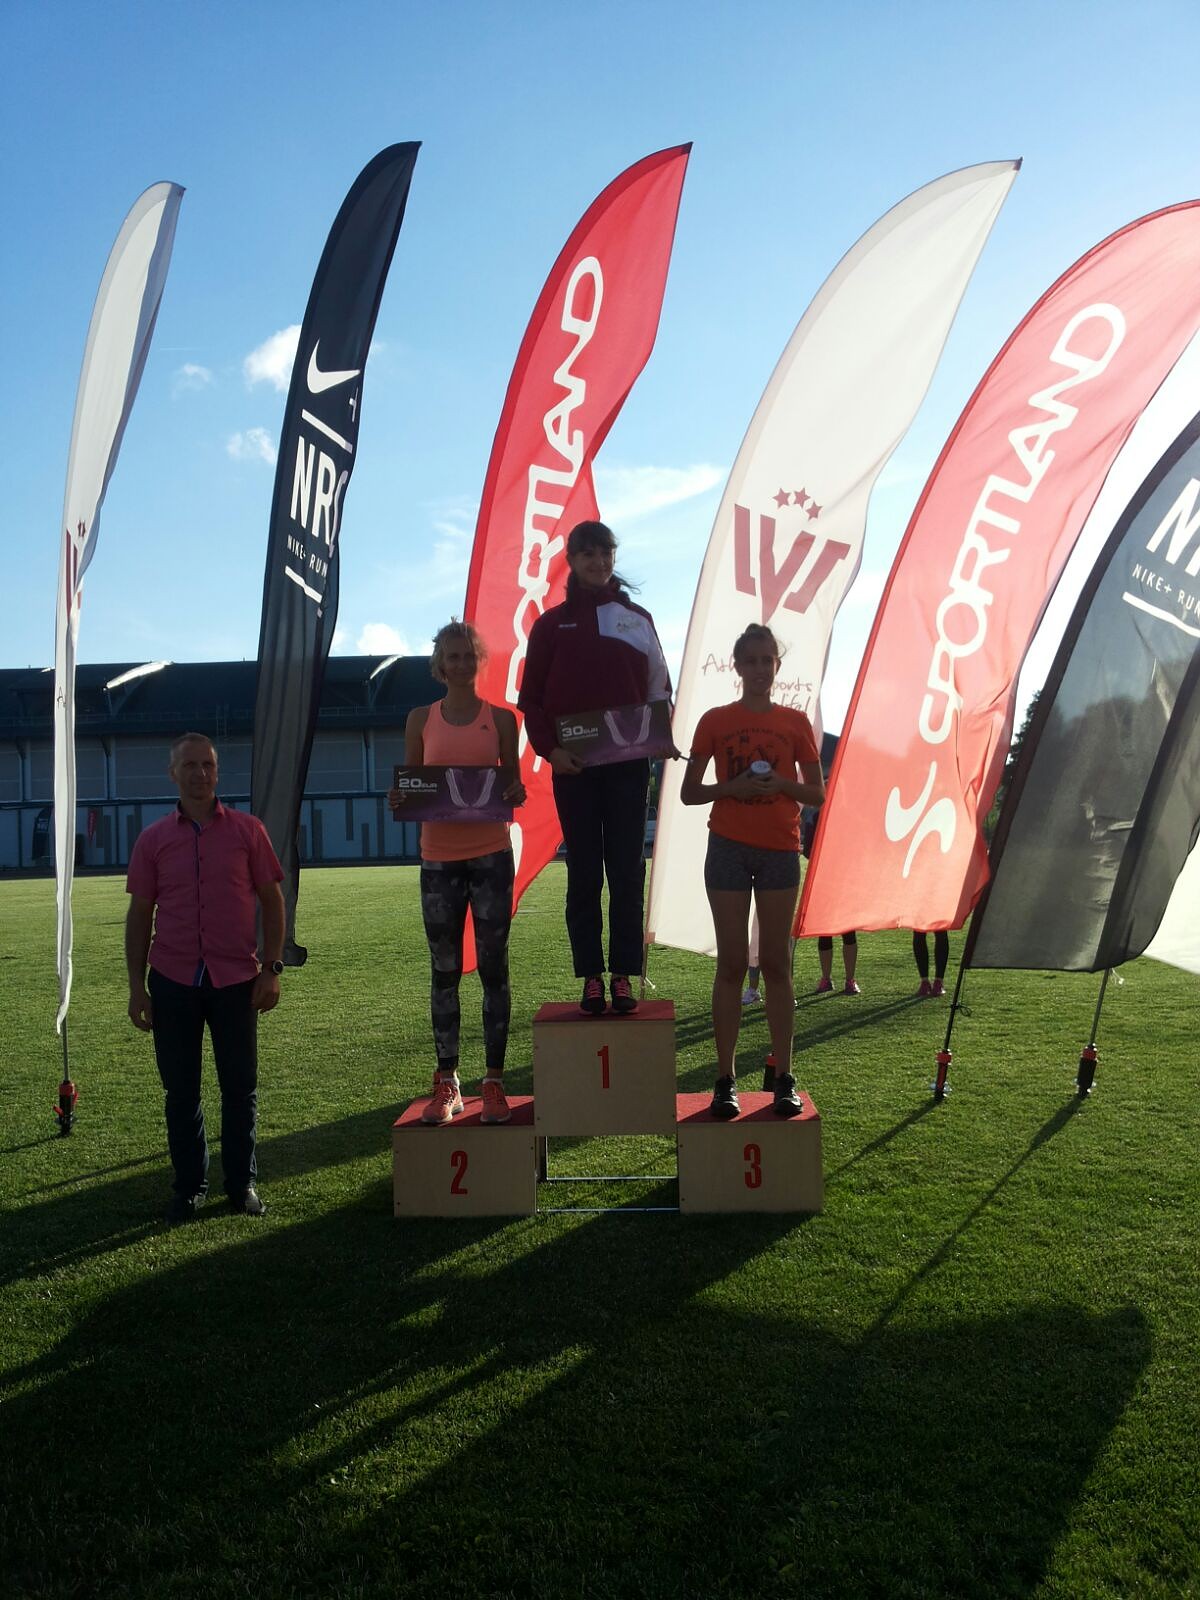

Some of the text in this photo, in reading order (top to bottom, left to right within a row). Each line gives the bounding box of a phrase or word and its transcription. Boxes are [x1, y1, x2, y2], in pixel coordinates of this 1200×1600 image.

[919, 303, 1126, 744] SPORTLAND
[1132, 563, 1172, 594] NIKE+
[767, 677, 813, 697] ports
[562, 725, 584, 738] 30
[399, 778, 422, 788] 20
[596, 1045, 610, 1089] 1
[450, 1150, 468, 1195] 2
[743, 1143, 762, 1189] 3
